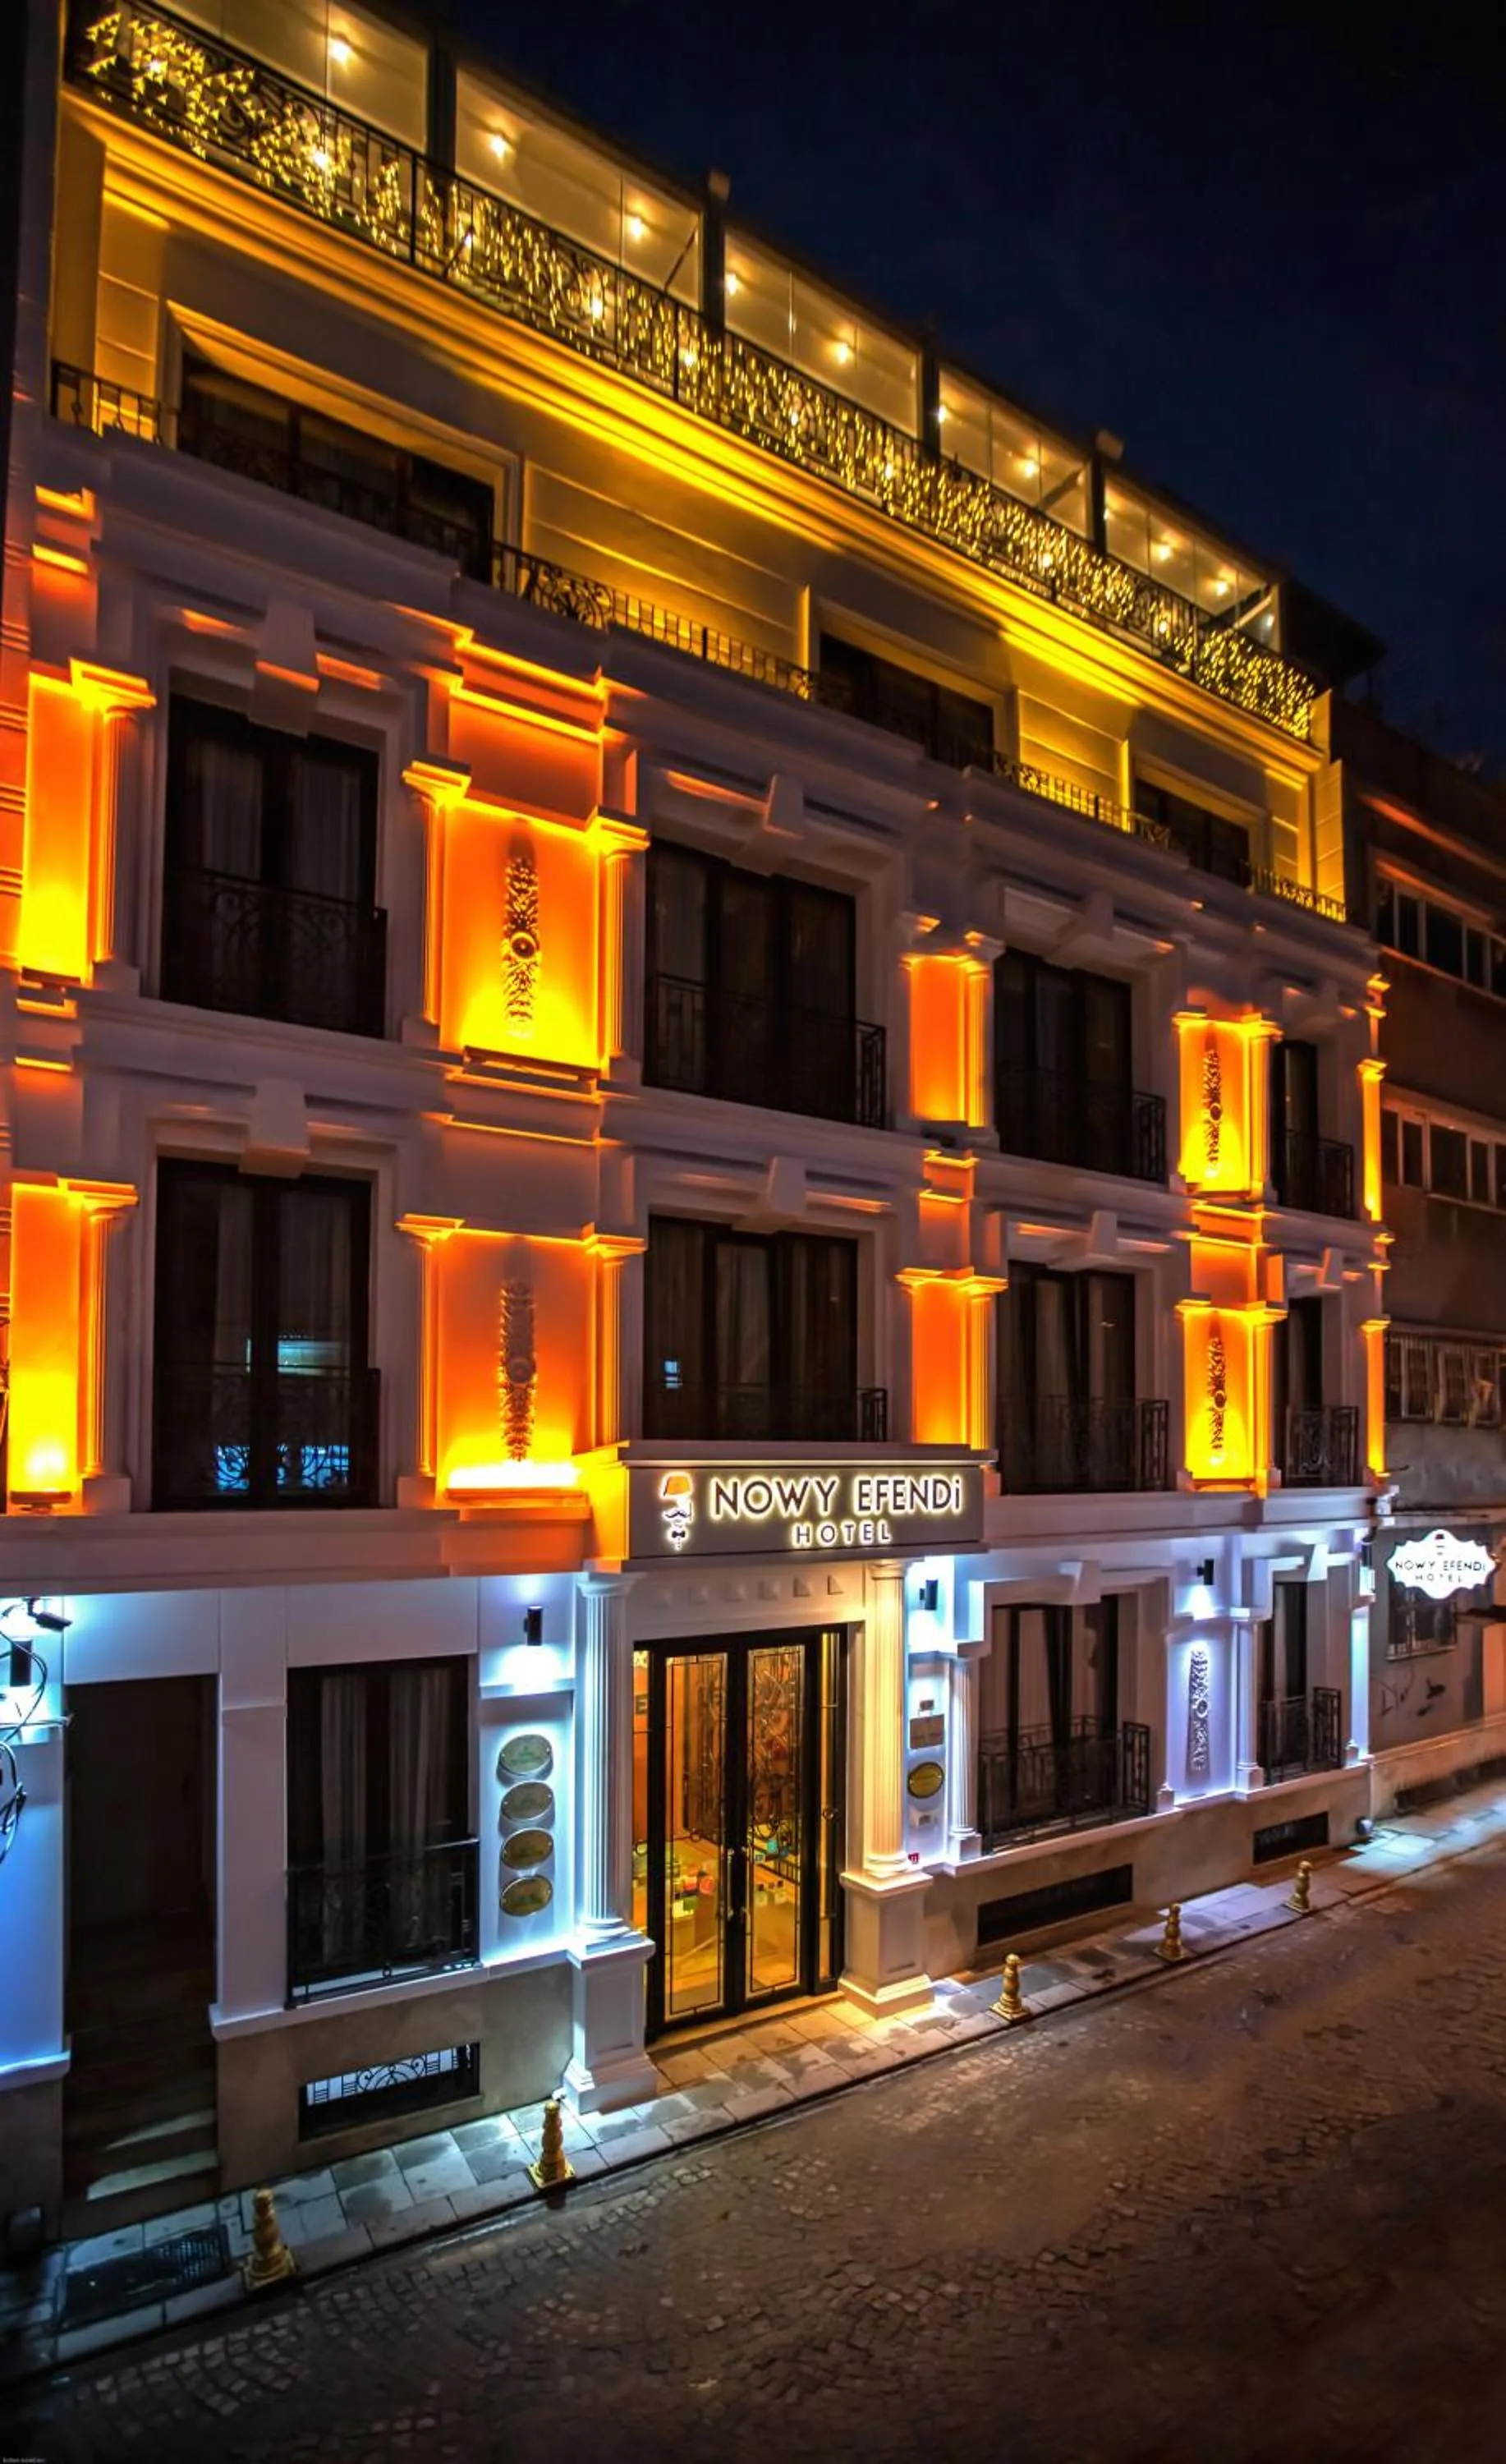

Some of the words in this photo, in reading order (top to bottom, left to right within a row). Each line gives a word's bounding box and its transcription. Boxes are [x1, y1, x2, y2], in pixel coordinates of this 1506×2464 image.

[714, 1478, 838, 1516] NOWY
[856, 1478, 961, 1513] EFENDi
[794, 1523, 892, 1545] HOTEL
[1395, 1560, 1435, 1570] NOWY
[1415, 1573, 1462, 1583] HOTEL
